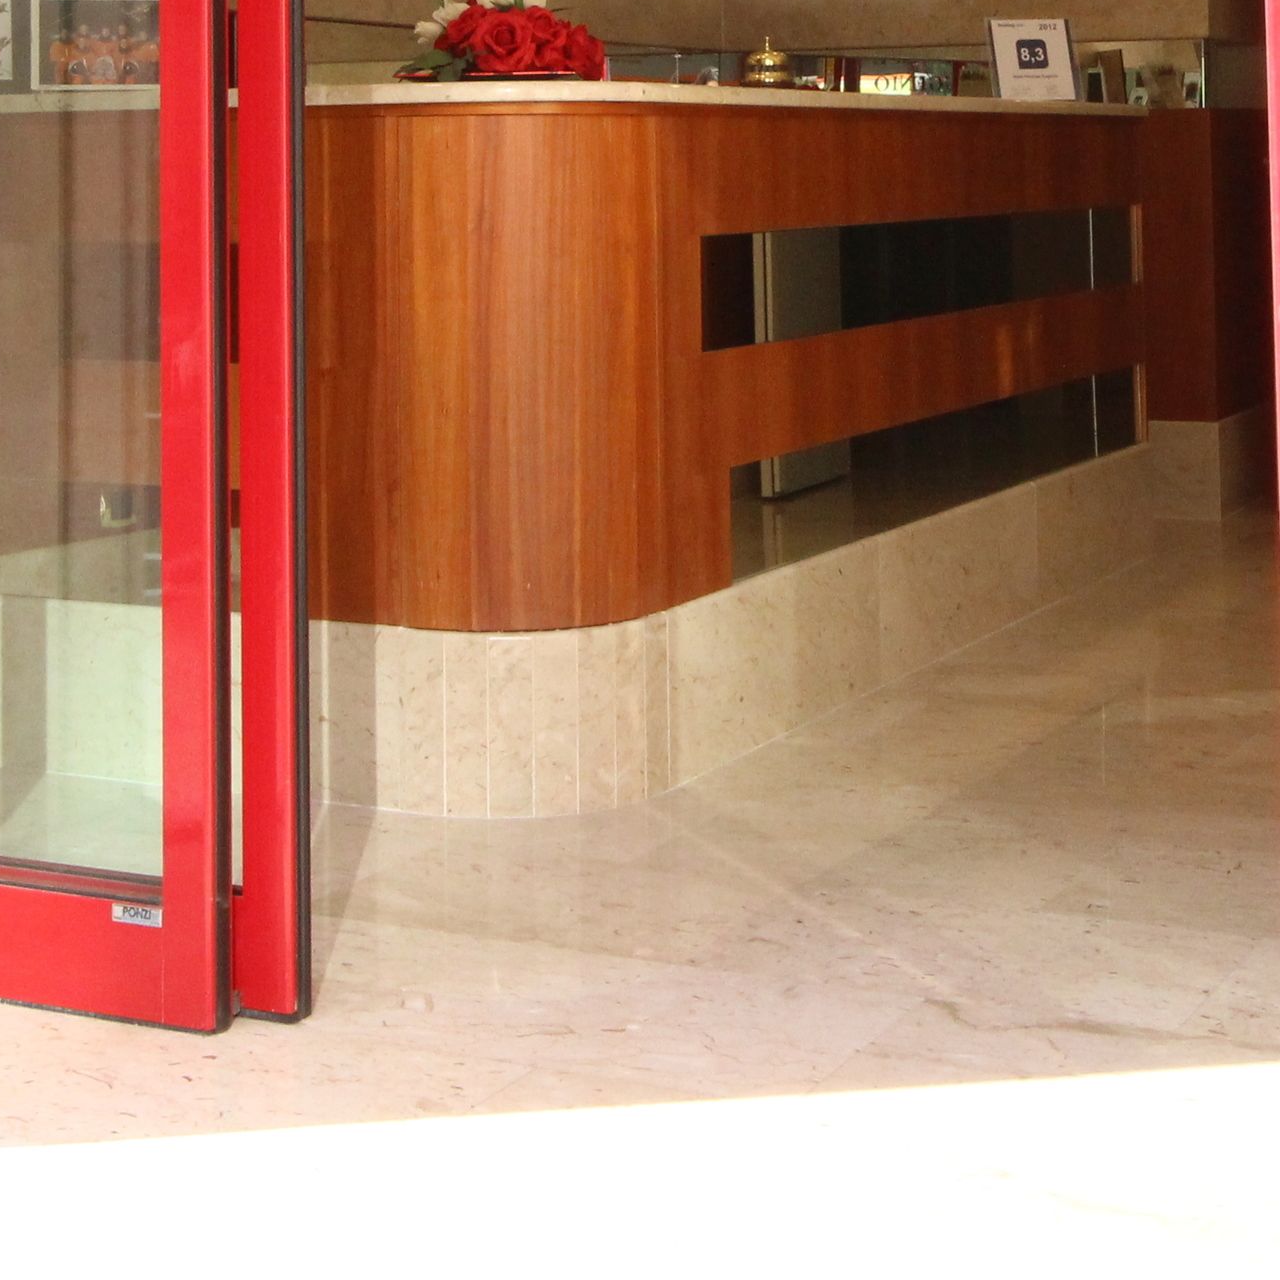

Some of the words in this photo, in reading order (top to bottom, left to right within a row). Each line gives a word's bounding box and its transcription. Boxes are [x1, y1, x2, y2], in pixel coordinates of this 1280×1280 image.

[1038, 23, 1057, 31] 2012
[1020, 47, 1045, 64] 8,3
[122, 906, 152, 920] PONZI
